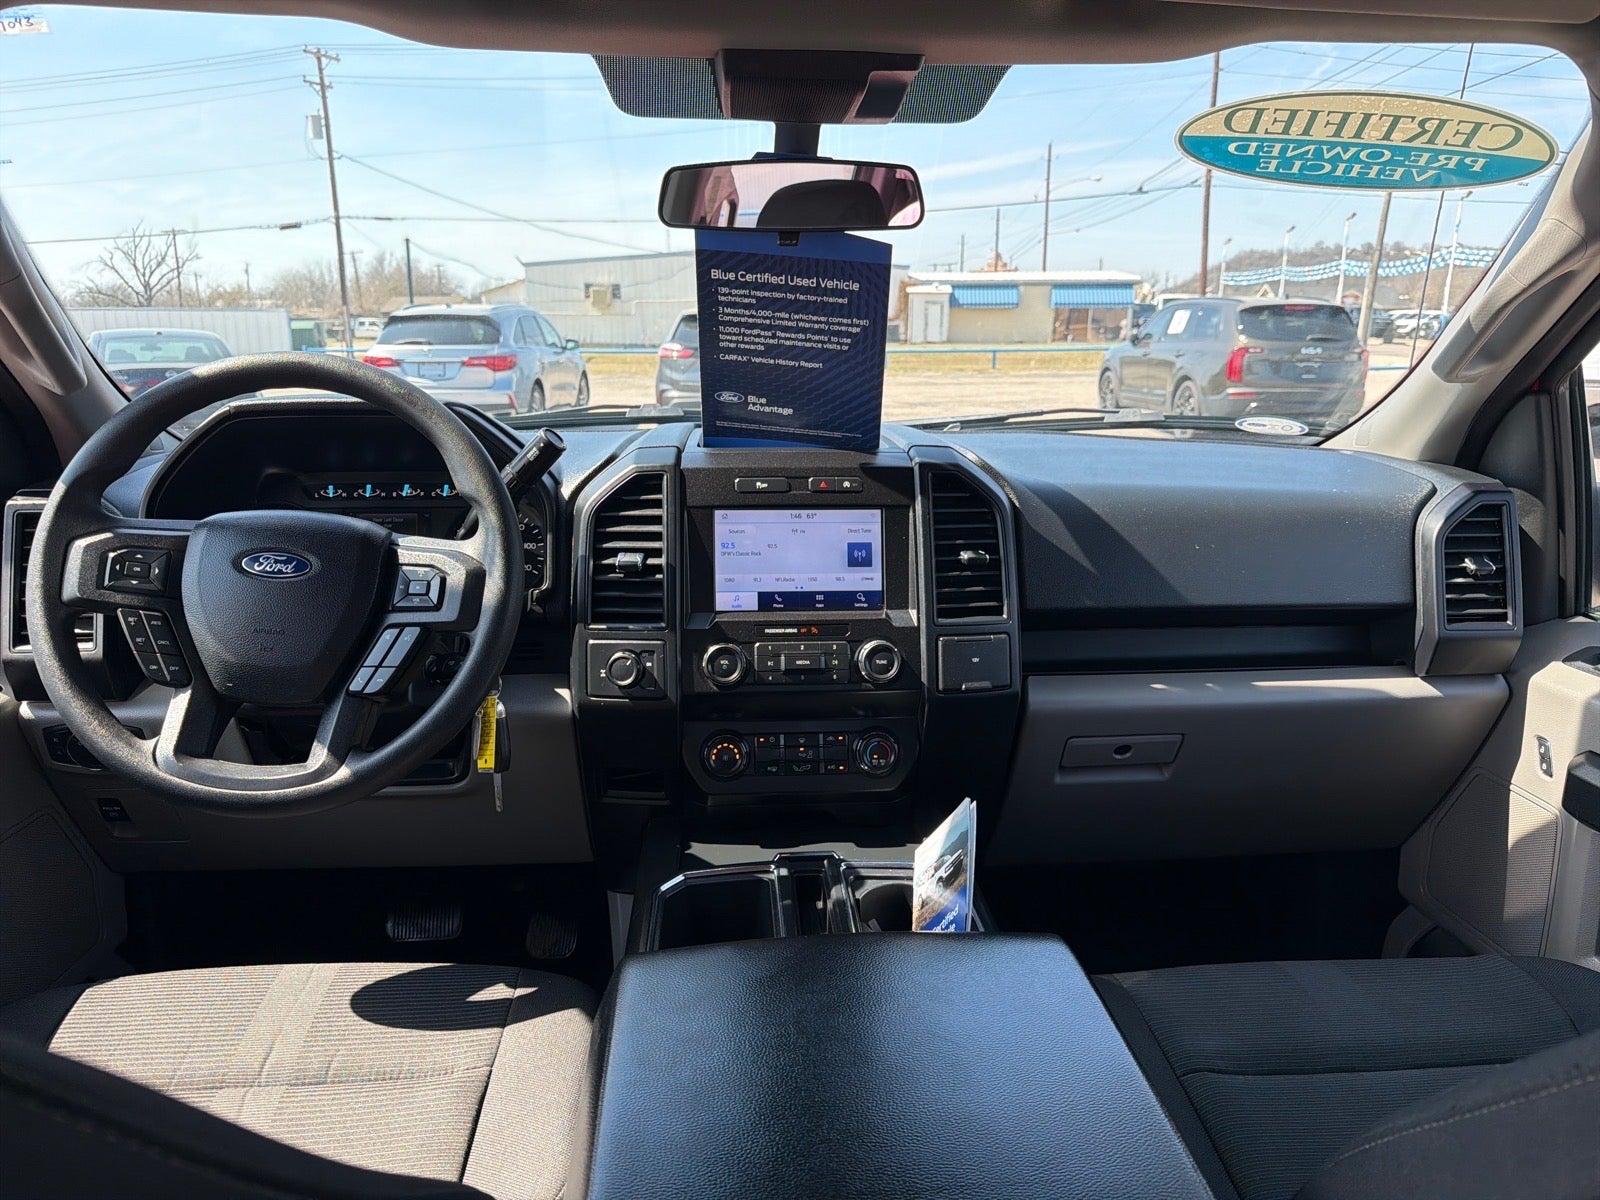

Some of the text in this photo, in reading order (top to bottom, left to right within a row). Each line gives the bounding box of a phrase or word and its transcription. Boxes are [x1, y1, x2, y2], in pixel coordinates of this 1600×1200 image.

[711, 268, 860, 291] Blue Certified Used Vehicle
[717, 286, 750, 295] 139-point
[786, 292, 796, 300] by
[797, 293, 848, 304] factory-trained
[718, 295, 757, 304] technicians
[718, 314, 771, 325] Comprehensive
[771, 318, 797, 327] Limited
[798, 320, 829, 331] Warranty
[790, 312, 828, 322] (whichever
[852, 318, 870, 328] first)
[719, 325, 740, 334] 11,000
[776, 331, 806, 339] Rewards
[719, 333, 743, 342] toward
[743, 335, 778, 345] scheduled
[778, 339, 823, 349] maintenance
[823, 342, 841, 350] visits
[737, 343, 765, 351] rewards
[750, 356, 775, 365] Vehicle
[775, 358, 800, 367] History
[800, 360, 823, 369] Report
[747, 395, 767, 404] Blue
[747, 403, 794, 416] Advantage
